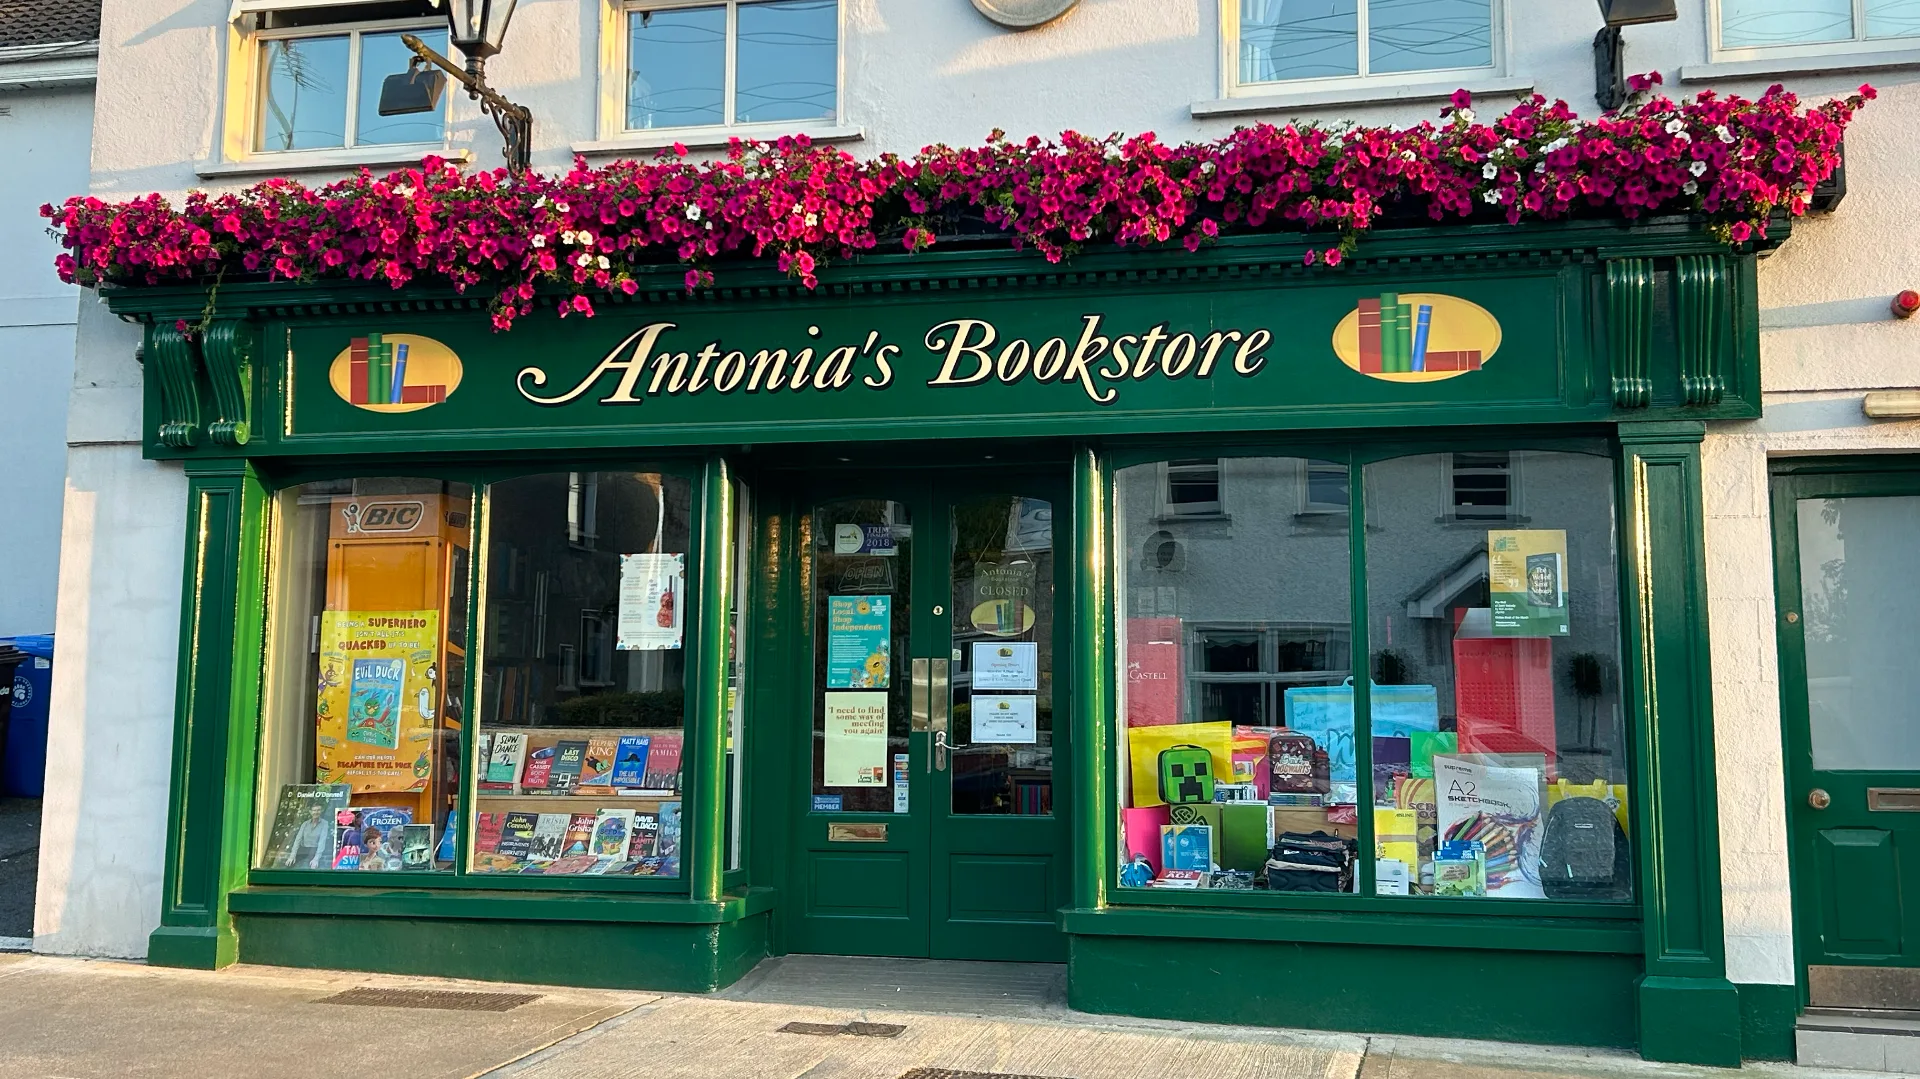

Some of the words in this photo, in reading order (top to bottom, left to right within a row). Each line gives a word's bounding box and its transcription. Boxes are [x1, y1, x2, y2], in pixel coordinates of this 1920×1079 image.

[516, 322, 900, 404] Antonia's
[924, 314, 1272, 404] Bookstore
[867, 539, 890, 547] 2018
[846, 565, 884, 580] OPEN
[981, 568, 1032, 578] Antonia's
[981, 586, 1028, 596] CLOSED
[368, 618, 427, 628] SUPERHERO
[338, 640, 386, 650] QUACKED
[376, 665, 401, 681] DUCK
[500, 734, 519, 744] SLOW
[495, 744, 518, 754] DANCE
[588, 747, 613, 756] KING
[649, 749, 678, 757] FAMILY
[1443, 765, 1472, 773] supreme
[1448, 779, 1477, 797] A2
[1448, 795, 1512, 808] SKETCHBOOK
[371, 818, 402, 826] FROZEN
[576, 817, 594, 825] John
[506, 822, 533, 831] Connolly
[345, 846, 361, 854] TAY
[342, 856, 359, 864] SW
